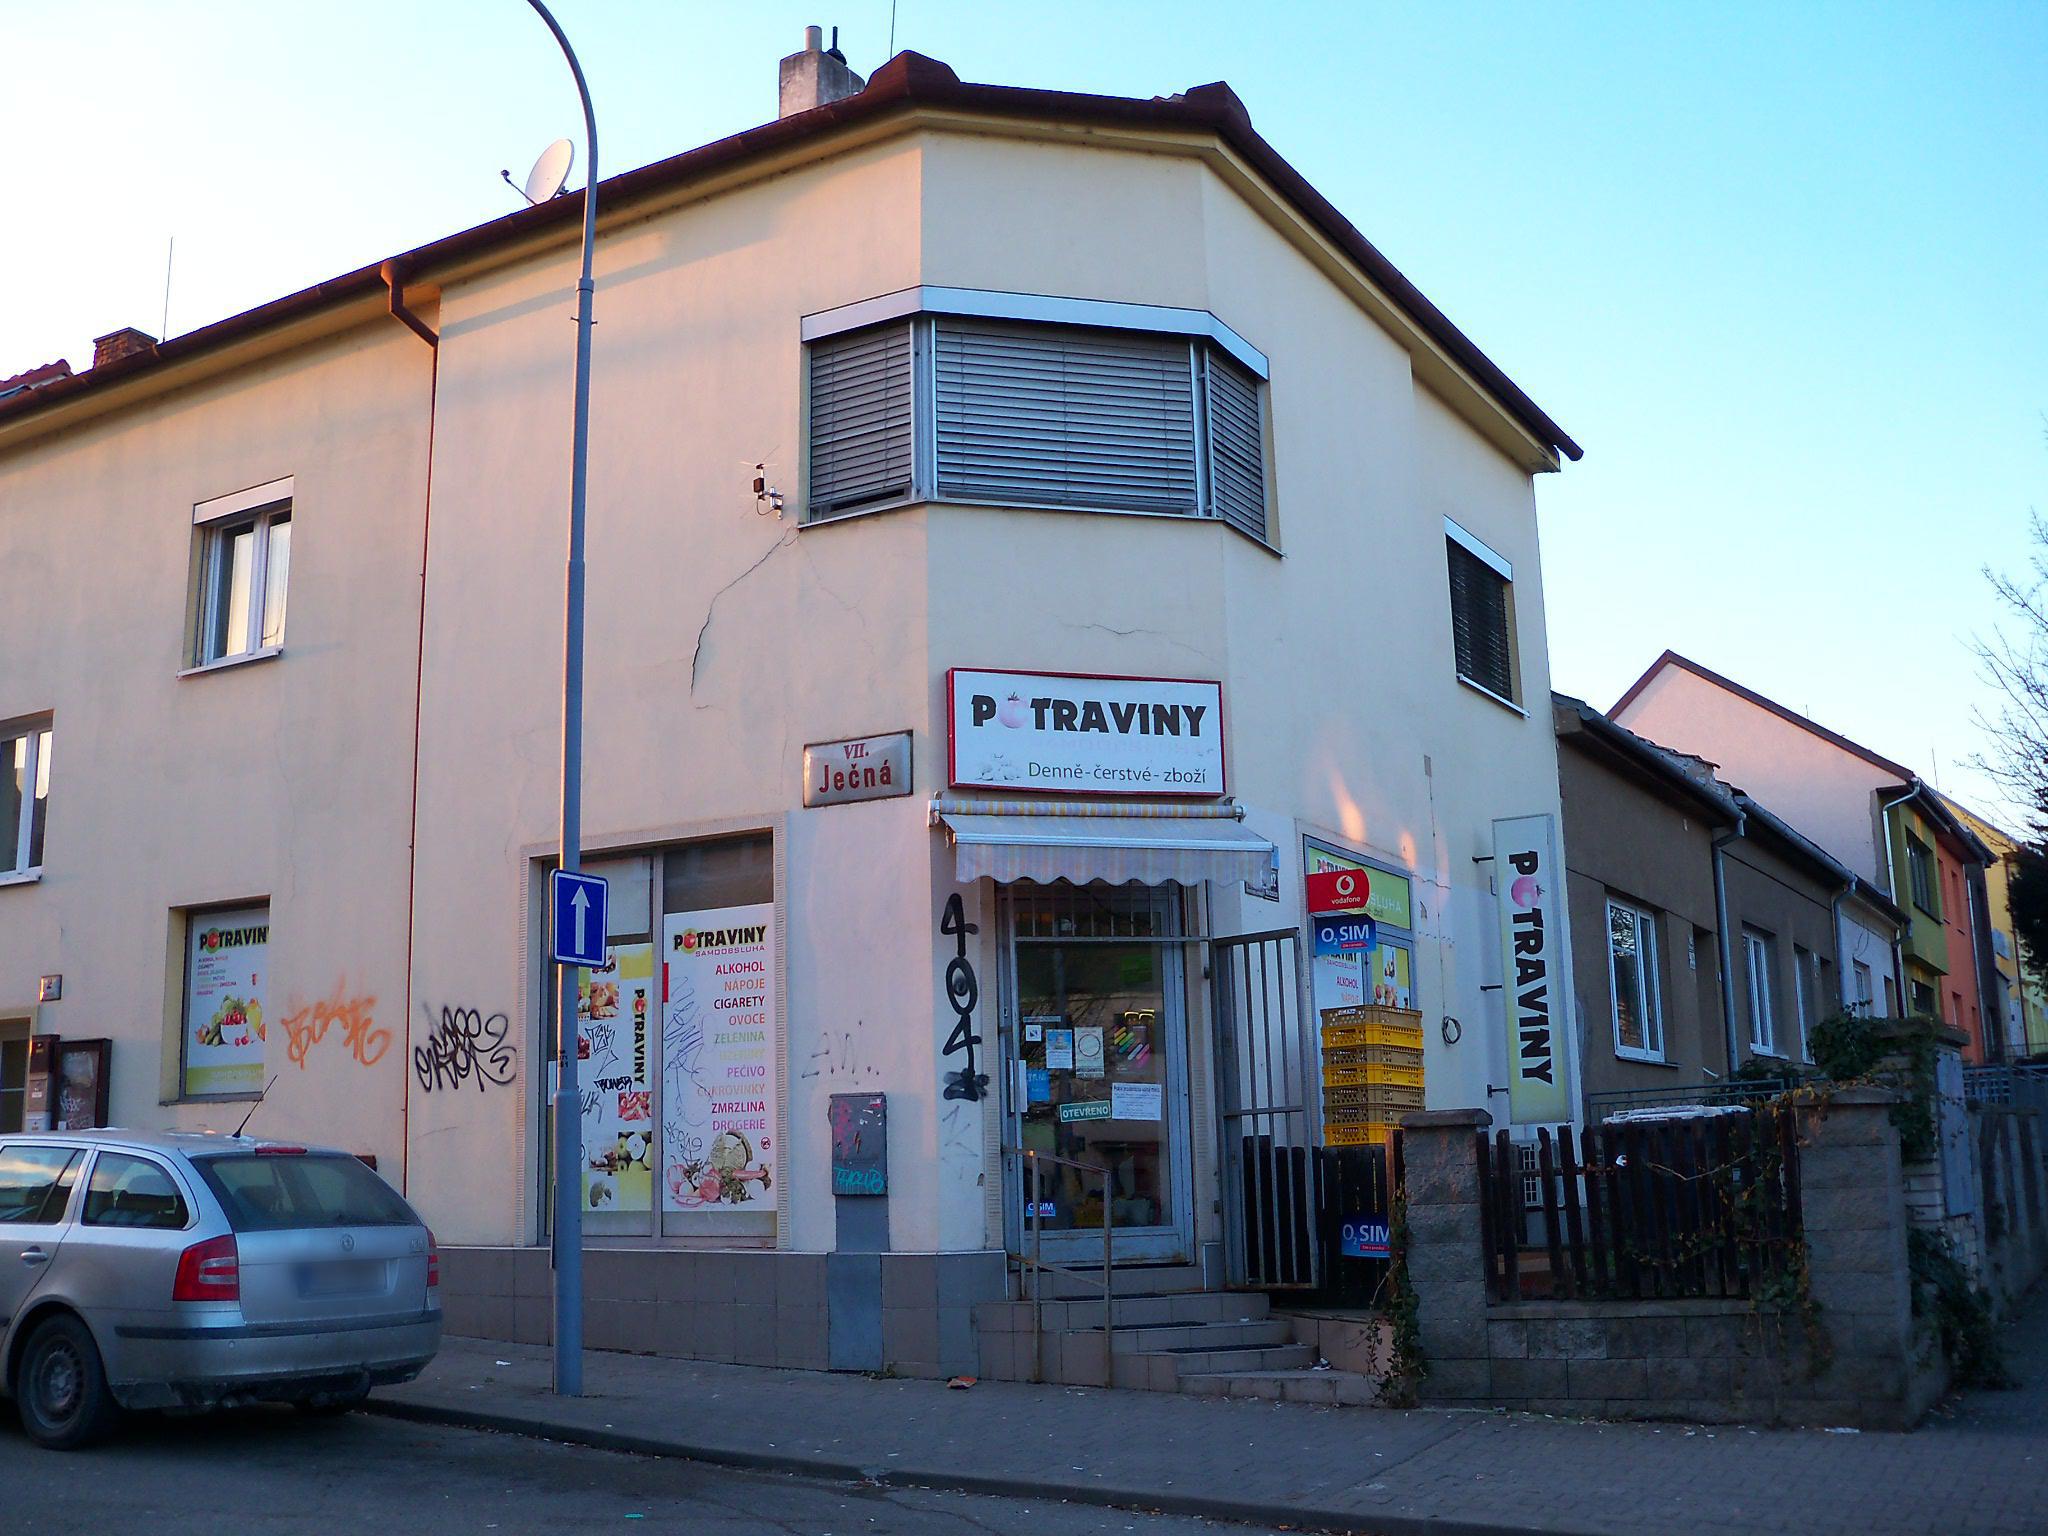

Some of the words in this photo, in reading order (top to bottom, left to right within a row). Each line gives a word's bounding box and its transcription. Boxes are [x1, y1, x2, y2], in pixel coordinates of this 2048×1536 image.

[843, 743, 869, 760] VII.
[819, 759, 892, 793] Ječná
[1331, 896, 1361, 905] vodafone
[200, 925, 270, 952] POTRAVIN
[1340, 924, 1369, 941] SIM
[715, 961, 765, 976] ALKOHOL
[714, 996, 765, 1010] CIGARETY
[729, 1013, 765, 1026] OVOCE
[714, 1032, 765, 1044] ZELENINA
[711, 1101, 765, 1114] ZMRZLINA
[712, 1119, 766, 1131] DROGERIE
